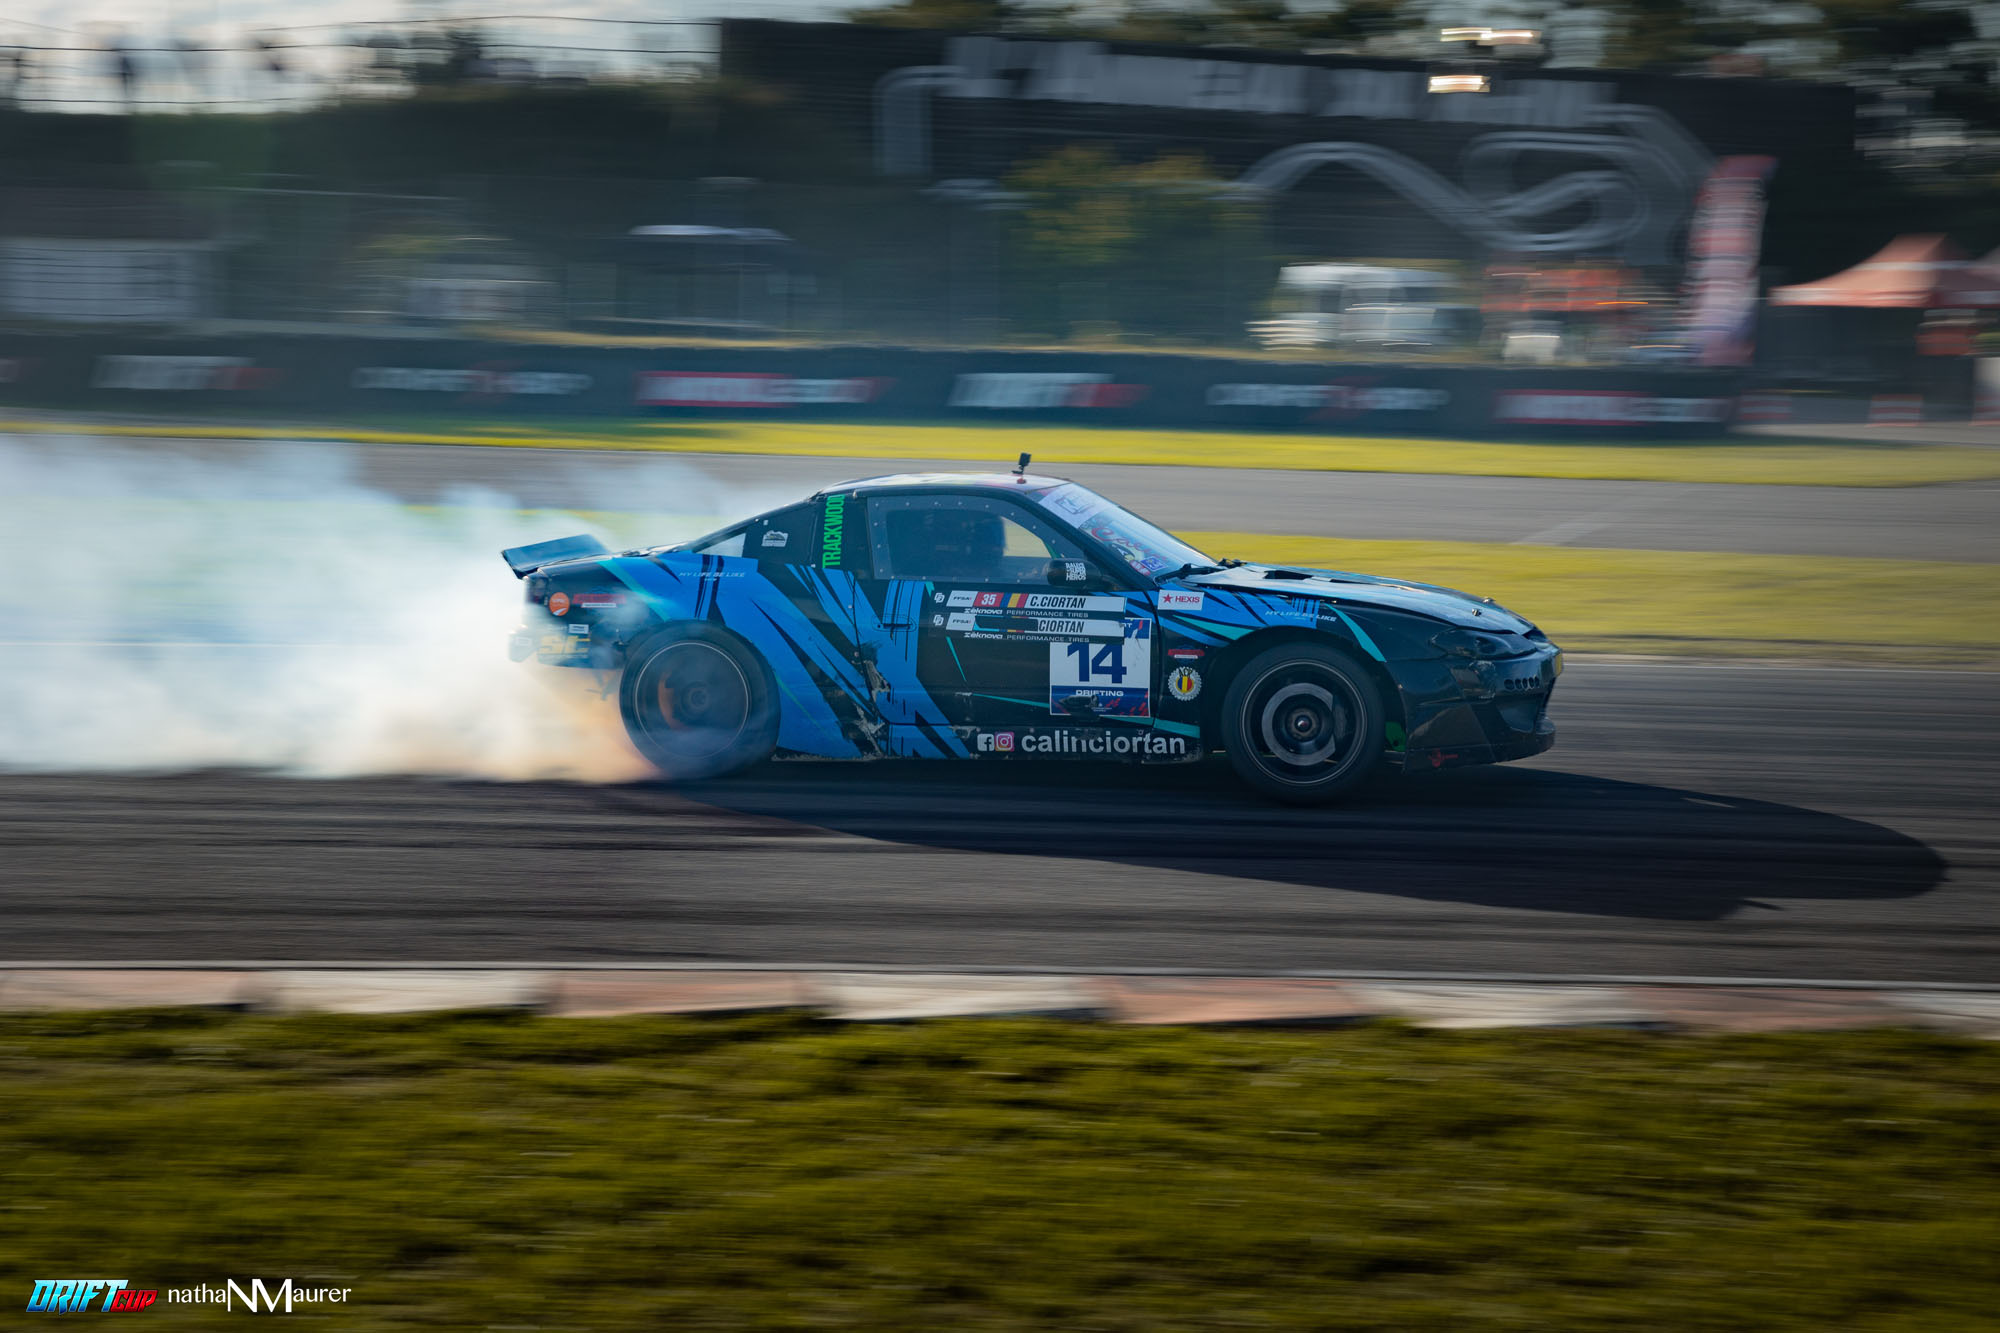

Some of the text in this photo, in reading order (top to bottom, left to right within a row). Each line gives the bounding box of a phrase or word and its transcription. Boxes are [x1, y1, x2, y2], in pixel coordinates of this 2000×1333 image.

[981, 594, 997, 605] 35
[1030, 596, 1087, 608] C.CIORTAN
[1006, 609, 1064, 617] PERFORMANCE
[1316, 614, 1337, 622] LIKE
[1038, 620, 1085, 633] CIORTAN
[1006, 634, 1065, 642] PERFORMANCE
[1067, 643, 1127, 684] 14
[1075, 689, 1124, 697] DRIFTING
[1021, 730, 1185, 754] calinciortan
